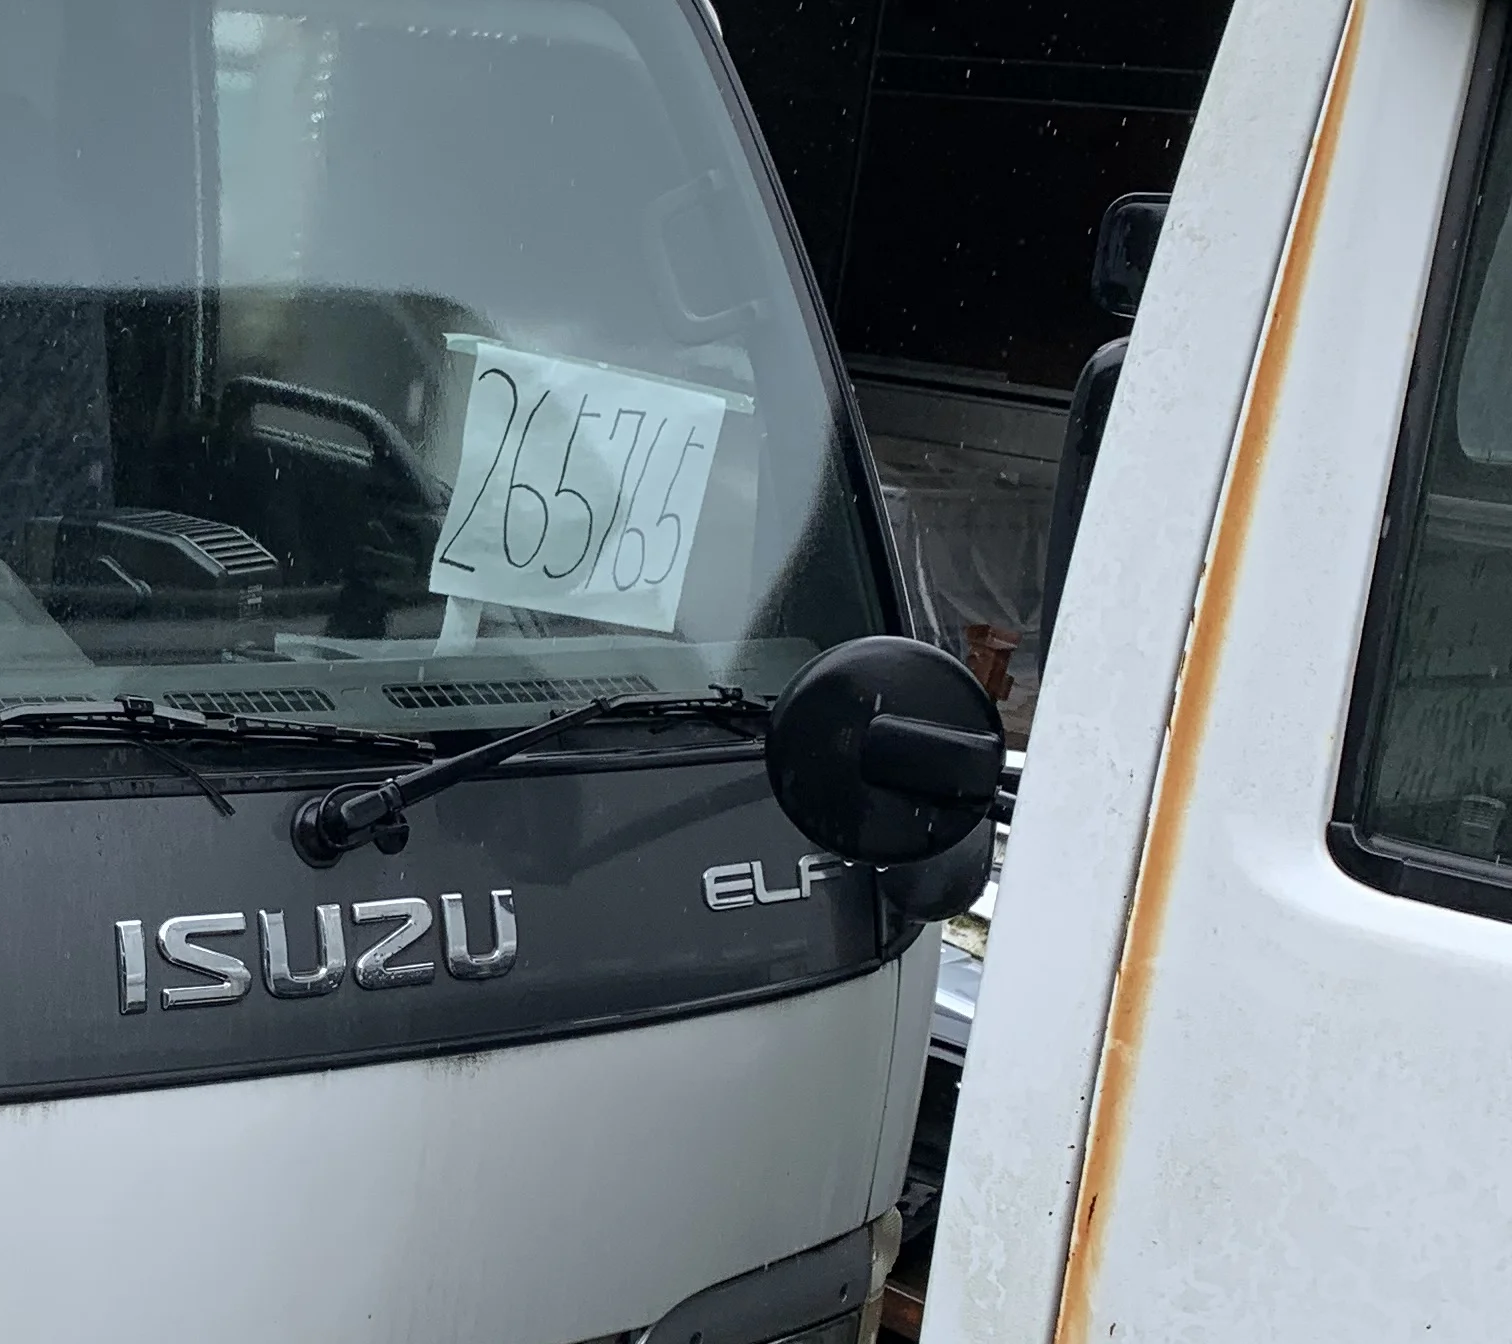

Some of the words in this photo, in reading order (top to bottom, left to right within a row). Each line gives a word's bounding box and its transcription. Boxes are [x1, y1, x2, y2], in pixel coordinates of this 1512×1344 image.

[439, 368, 704, 592] 265765
[702, 853, 842, 910] ELF
[115, 889, 518, 1014] ISUZU
